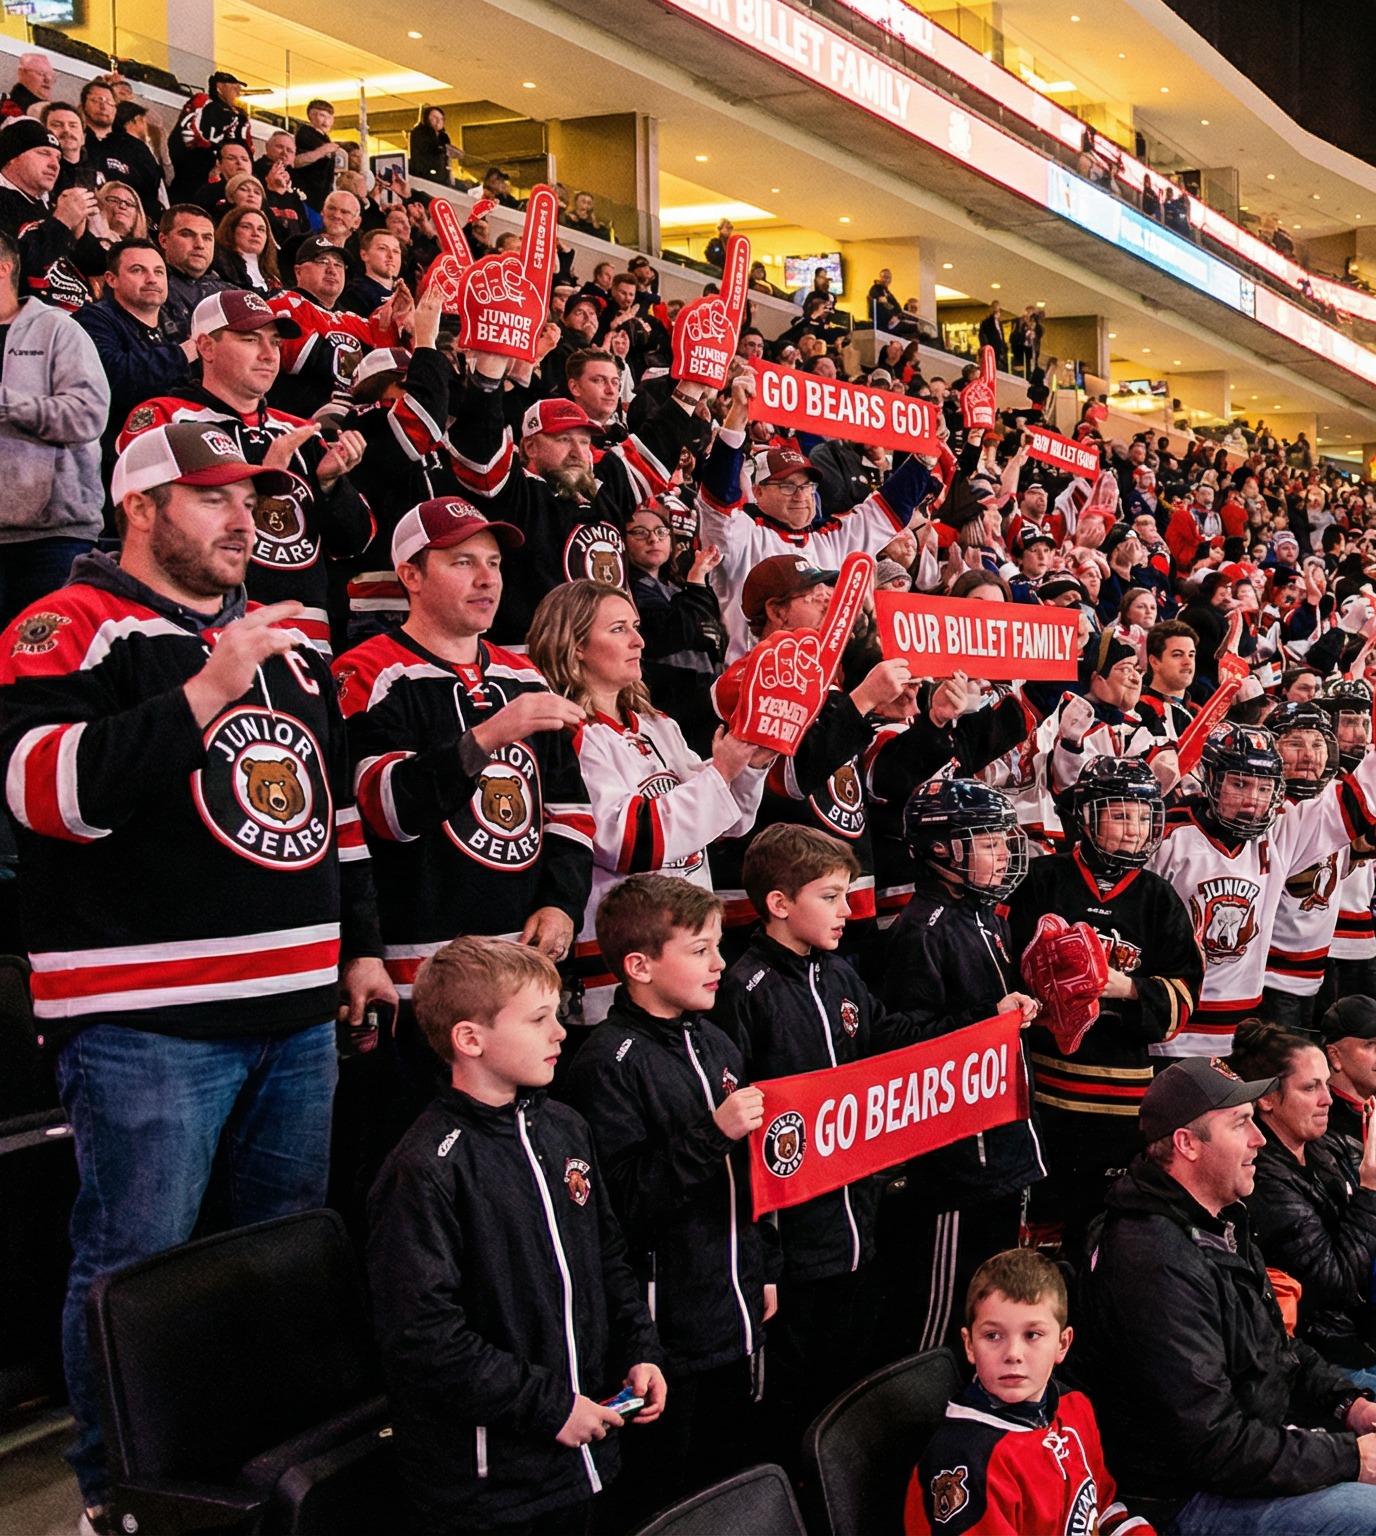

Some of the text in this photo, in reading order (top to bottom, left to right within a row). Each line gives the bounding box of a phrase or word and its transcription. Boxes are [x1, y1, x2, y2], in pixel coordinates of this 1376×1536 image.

[736, 0, 824, 73] BILLET
[830, 40, 911, 120] FAMILY
[477, 322, 530, 350] BEARS
[763, 371, 798, 412] GO
[804, 379, 885, 429] BEARS
[891, 400, 930, 438] GO!
[253, 536, 314, 562] EARS
[893, 611, 941, 653] OUR
[944, 615, 1008, 657] BILLET
[1012, 621, 1075, 661] FAMILY
[283, 650, 320, 696] C
[214, 717, 312, 762] JUNIOR
[236, 817, 326, 858] BEARS
[468, 826, 539, 861] BEARS
[1204, 879, 1259, 903] JUNIOR
[814, 1044, 1007, 1157] GO BEARS GO!
